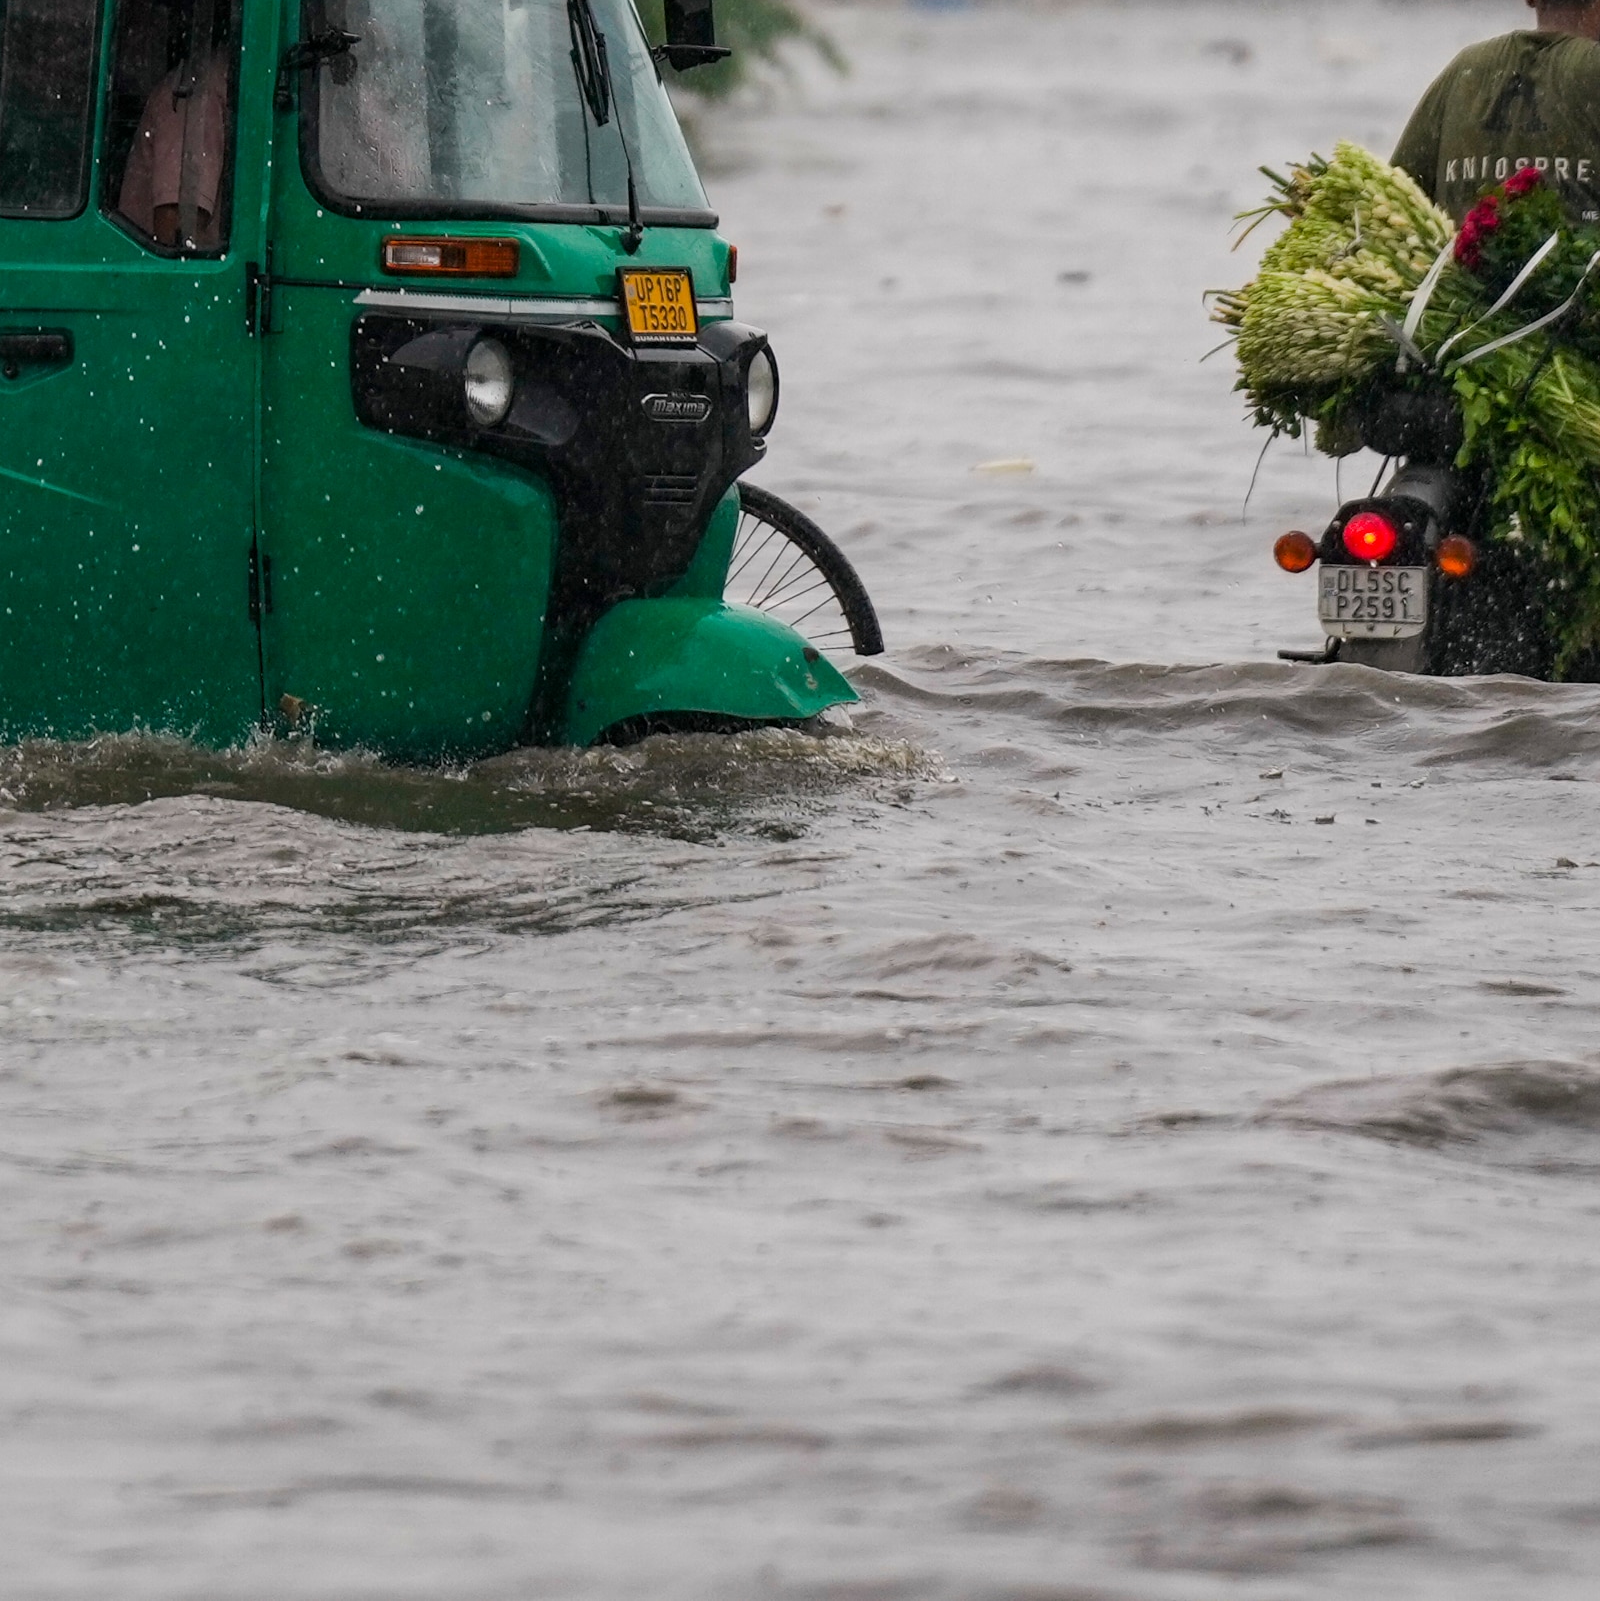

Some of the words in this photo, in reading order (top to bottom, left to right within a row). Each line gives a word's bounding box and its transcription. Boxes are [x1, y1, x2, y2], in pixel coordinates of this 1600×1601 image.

[639, 305, 687, 330] T5330
[653, 399, 706, 414] Maxima
[1337, 569, 1410, 594] DL5SC
[1337, 595, 1408, 619] P2591
